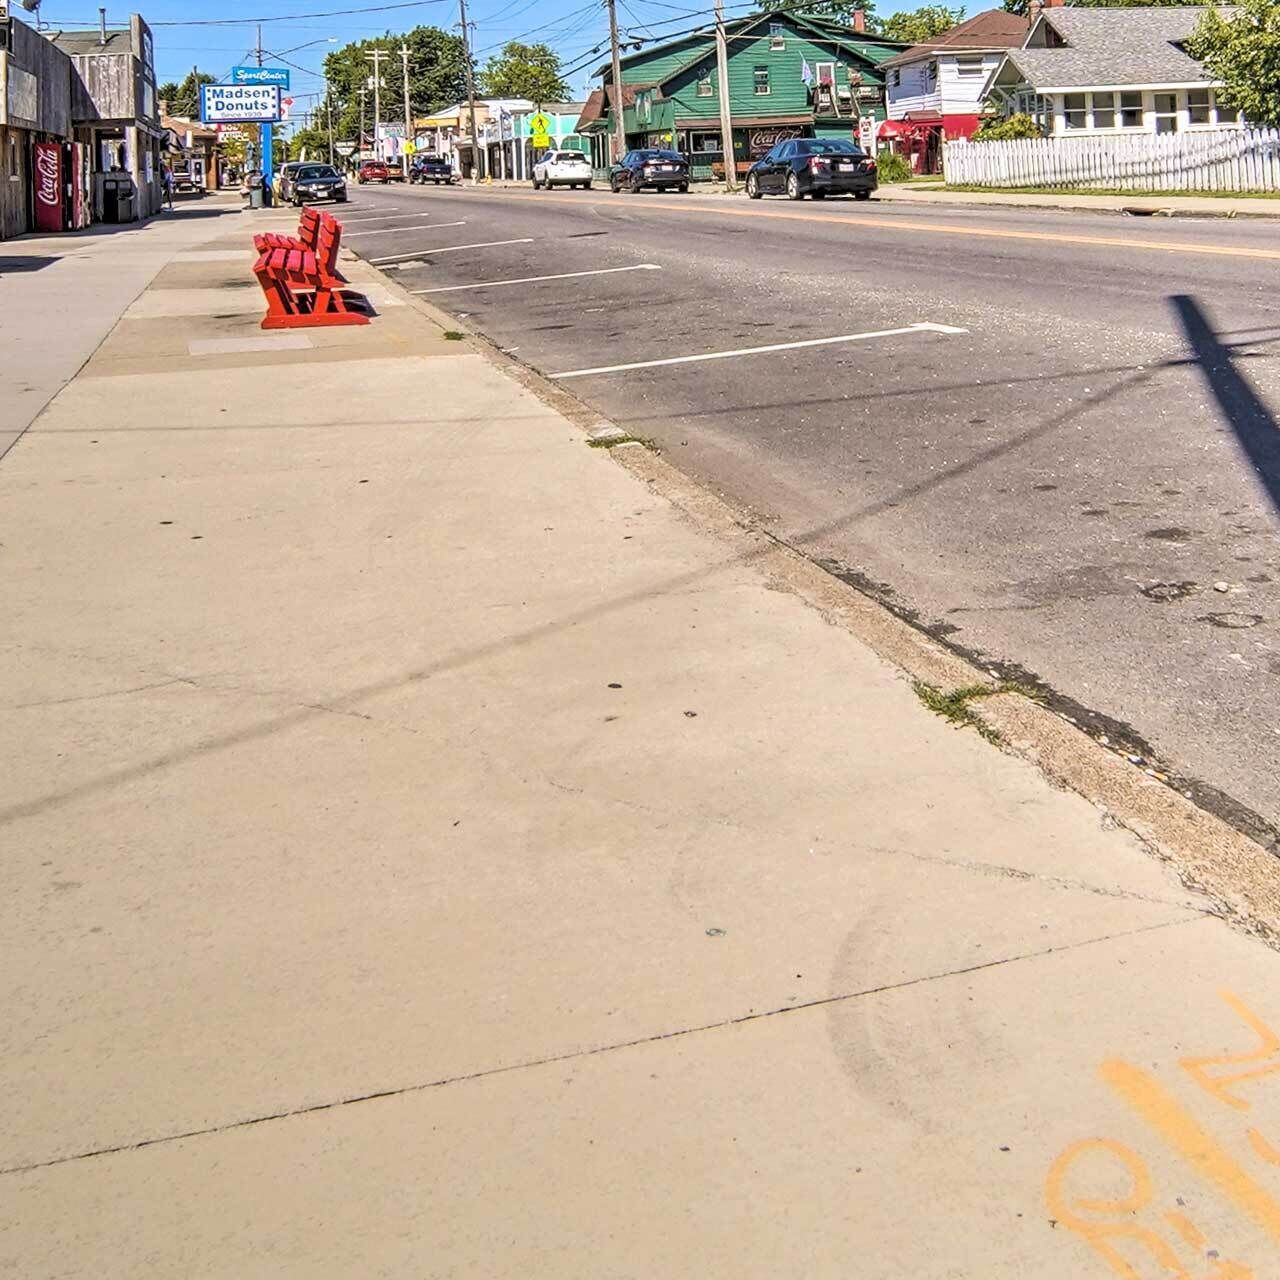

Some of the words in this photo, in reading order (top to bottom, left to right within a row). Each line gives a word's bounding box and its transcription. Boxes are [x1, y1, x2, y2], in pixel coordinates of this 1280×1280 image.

[212, 88, 270, 99] Madsen
[215, 100, 269, 111] Donuts
[750, 128, 802, 149] Coca-C
